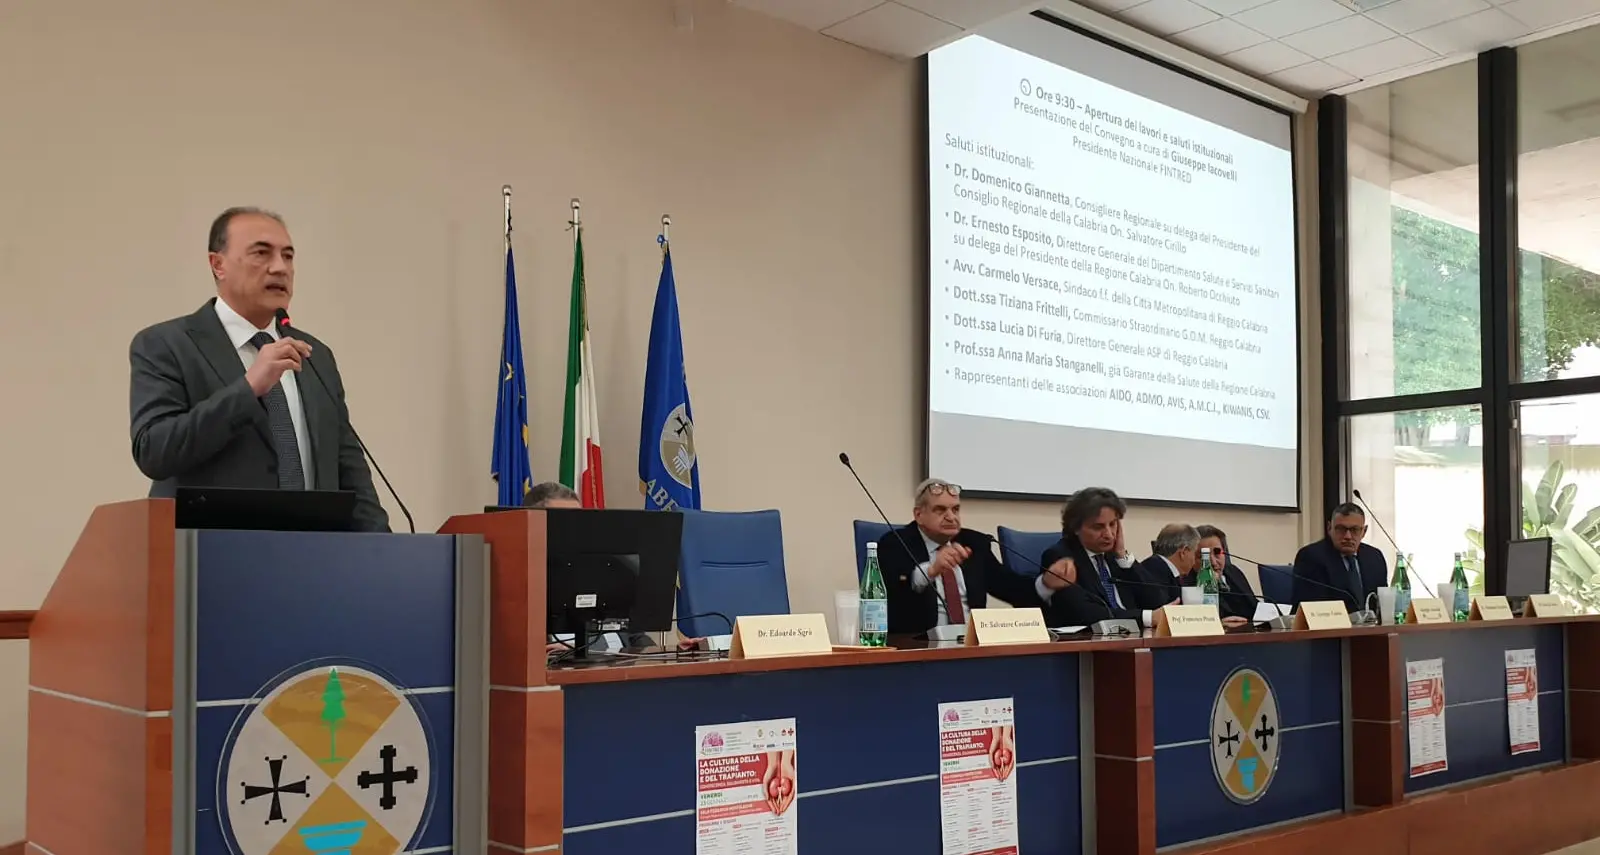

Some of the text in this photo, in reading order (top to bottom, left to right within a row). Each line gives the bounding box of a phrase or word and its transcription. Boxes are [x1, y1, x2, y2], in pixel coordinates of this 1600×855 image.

[944, 132, 1035, 170] Saluti istituzionali:
[1014, 97, 1237, 182] Presentazione del Convegno a cura di Giuseppe Iacovelli
[1036, 86, 1053, 103] Ore
[1055, 93, 1075, 110] 9:30
[1085, 104, 1122, 126] Apertura
[1139, 120, 1161, 140] lavori
[1162, 133, 1169, 143] e
[1170, 135, 1191, 150] saluti
[1192, 140, 1234, 165] istituzionali
[1073, 136, 1192, 184] Presidente Nazionale FINTRED
[953, 183, 1187, 254] Consiglio Regionale della Calabria On. Salvatore Cirillo
[954, 163, 969, 179] Dr.
[971, 168, 1022, 193] Domenico
[1024, 182, 1073, 209] Giannetta,
[1074, 197, 1121, 219] Consigliere
[1123, 209, 1162, 230] Regionale
[1163, 222, 1172, 233] su
[1173, 224, 1198, 242] delega
[1212, 234, 1249, 254] Presidente
[953, 211, 968, 226] Dr.
[971, 215, 1009, 235] Ernesto
[1012, 224, 1054, 248] Esposito,
[1056, 235, 1096, 256] Direttore
[1098, 246, 1135, 265] Generale
[1151, 258, 1201, 280] Dipartimento
[1202, 271, 1224, 287] Salute
[953, 234, 1241, 306] su delega del Presidente della Regione Calabria On. Roberto Occhiuto
[953, 259, 975, 274] Avv.
[978, 263, 1020, 283] Carmelo
[1022, 272, 1061, 293] Versace,
[1063, 280, 1098, 299] Sindaco
[1111, 291, 1131, 306] della
[1153, 300, 1207, 322] Metropolitana
[1208, 311, 1215, 323] di
[1217, 313, 1240, 329] Reggio
[1241, 319, 1268, 334] Calabria
[953, 286, 1262, 355] Dott.ssa Tiziana Frittelli, Commissario Straordinario G.O.M. Reggio Calabria
[953, 313, 1229, 371] Dott.ssa Lucia Di Furia, Direttore Generale ASP di Reggio Calabria
[954, 340, 995, 358] Prof.ssa
[997, 346, 1023, 362] Anna
[1025, 351, 1053, 367] Maria
[1055, 355, 1107, 376] Stanganelli,
[1123, 366, 1155, 382] Garante
[1156, 371, 1176, 386] della
[1177, 375, 1200, 389] Salute
[1201, 379, 1220, 392] della
[1221, 381, 1249, 396] Regione
[954, 367, 1030, 389] Rappresentanti
[1031, 378, 1054, 392] delle
[1056, 383, 1107, 399] associazioni
[1109, 388, 1134, 404] AIDO,
[1136, 392, 1165, 408] ADMO,
[1167, 396, 1187, 411] AVIS,
[1222, 403, 1255, 420] KIWANIS,
[1256, 408, 1271, 420] CSV.
[758, 630, 768, 638] Dr.
[769, 630, 797, 638] Edoardo
[700, 755, 760, 768] LA CULTURA DELLA
[700, 764, 740, 775] DONAZIONE
[705, 774, 718, 782] DEL
